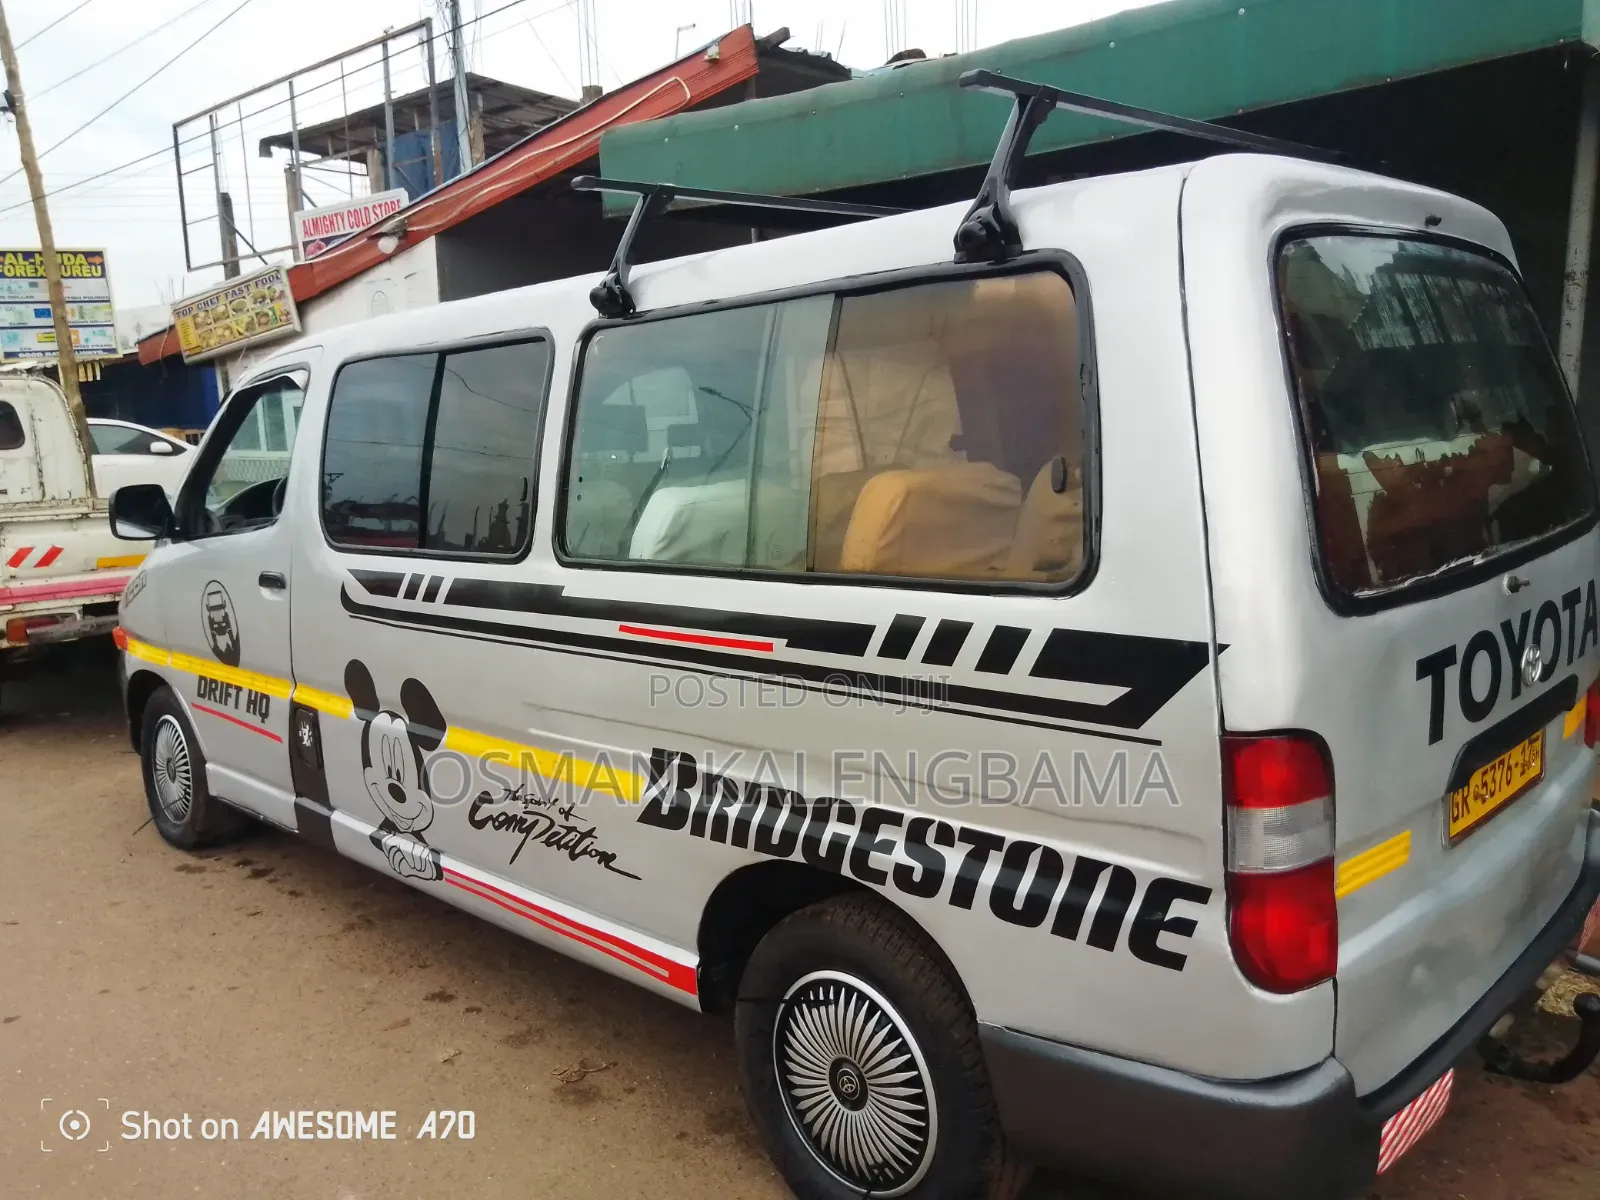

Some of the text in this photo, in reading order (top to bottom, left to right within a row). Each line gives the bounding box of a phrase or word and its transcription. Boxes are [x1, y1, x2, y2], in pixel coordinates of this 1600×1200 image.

[303, 212, 345, 238] ALMIGHTY
[346, 206, 371, 230] COLD
[0, 264, 102, 277] OREX UREU
[176, 306, 194, 318] TOP
[197, 296, 222, 311] CHEF
[225, 284, 251, 300] FAST
[1416, 579, 1598, 746] TOYOTA
[197, 674, 271, 724] DRIFT HQ
[636, 747, 1213, 972] BRIDGESTONE
